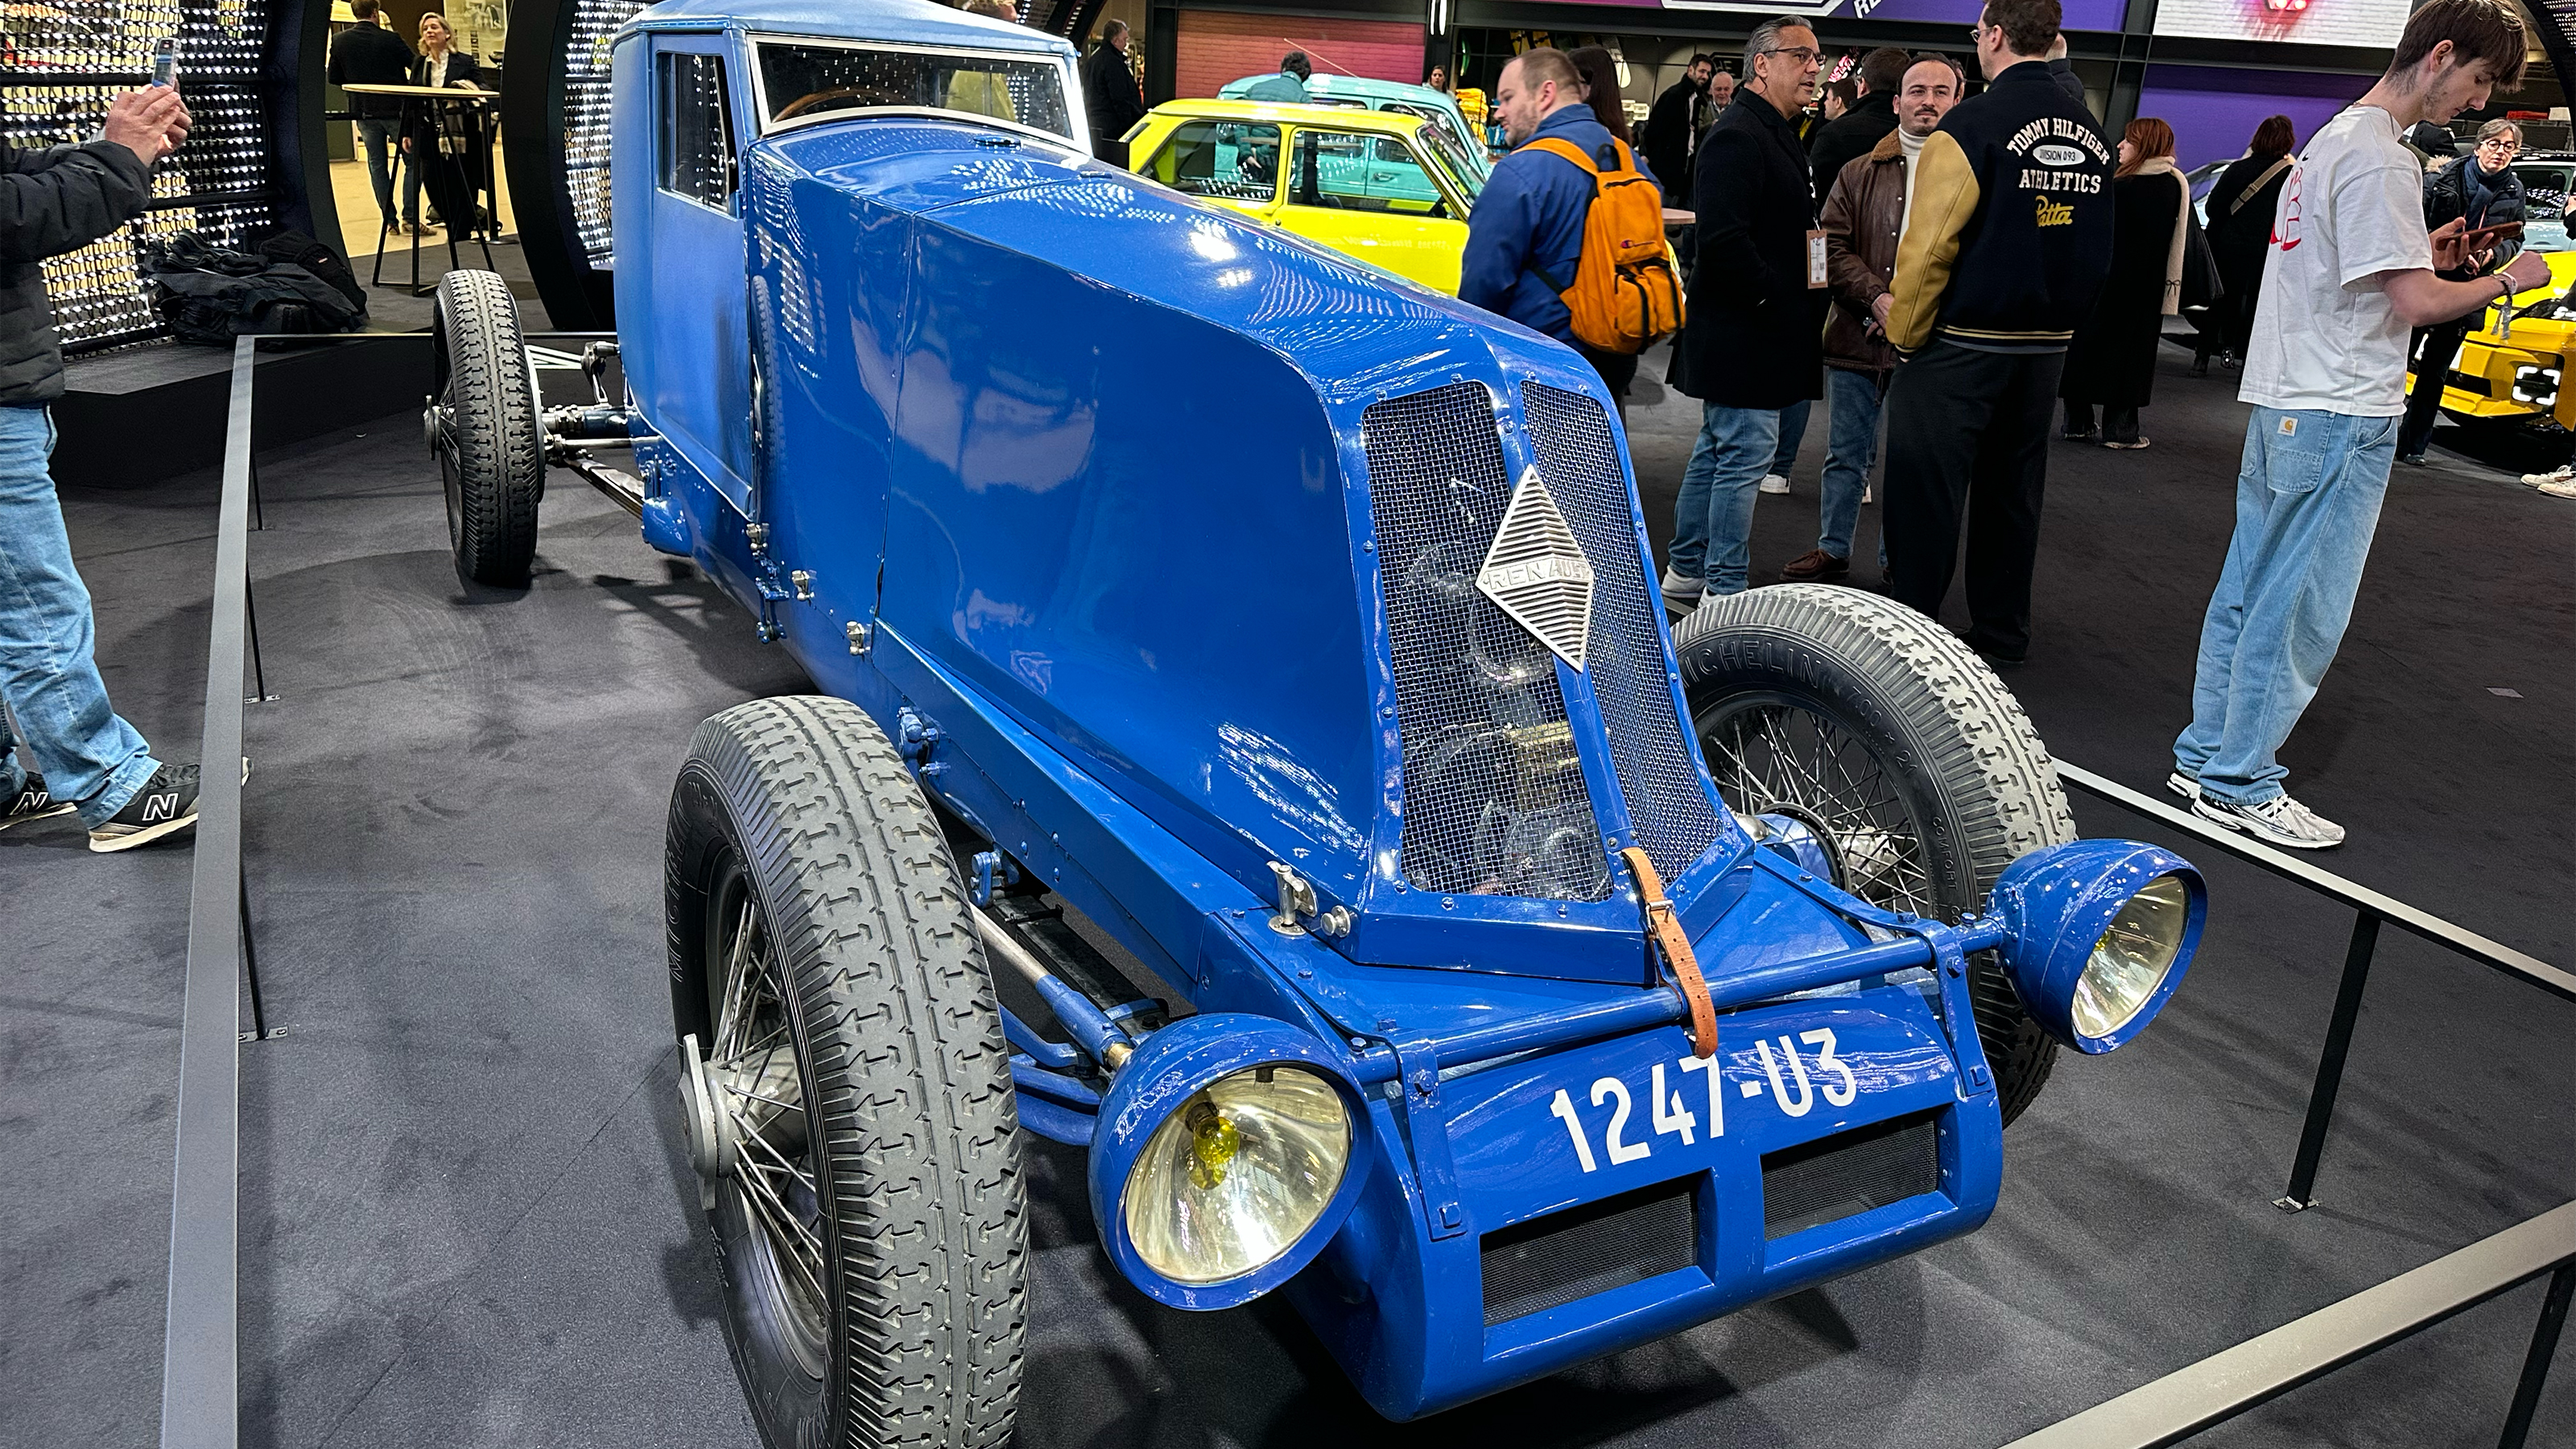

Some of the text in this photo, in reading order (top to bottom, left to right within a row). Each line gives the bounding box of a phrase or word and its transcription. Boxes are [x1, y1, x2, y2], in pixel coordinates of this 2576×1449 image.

[2006, 118, 2111, 166] TOMMY HILFIGER
[2063, 151, 2076, 162] 093
[2018, 169, 2102, 194] ATHLETICS
[2035, 195, 2074, 227] Patta
[1488, 558, 1588, 590] RENAULT
[1681, 641, 1822, 690] ICHELIN
[1895, 749, 1918, 776] 21
[9, 792, 48, 815] N
[142, 793, 179, 821] N
[1932, 816, 1959, 891] COMFORT
[1550, 1027, 1856, 1174] 1247-U3
